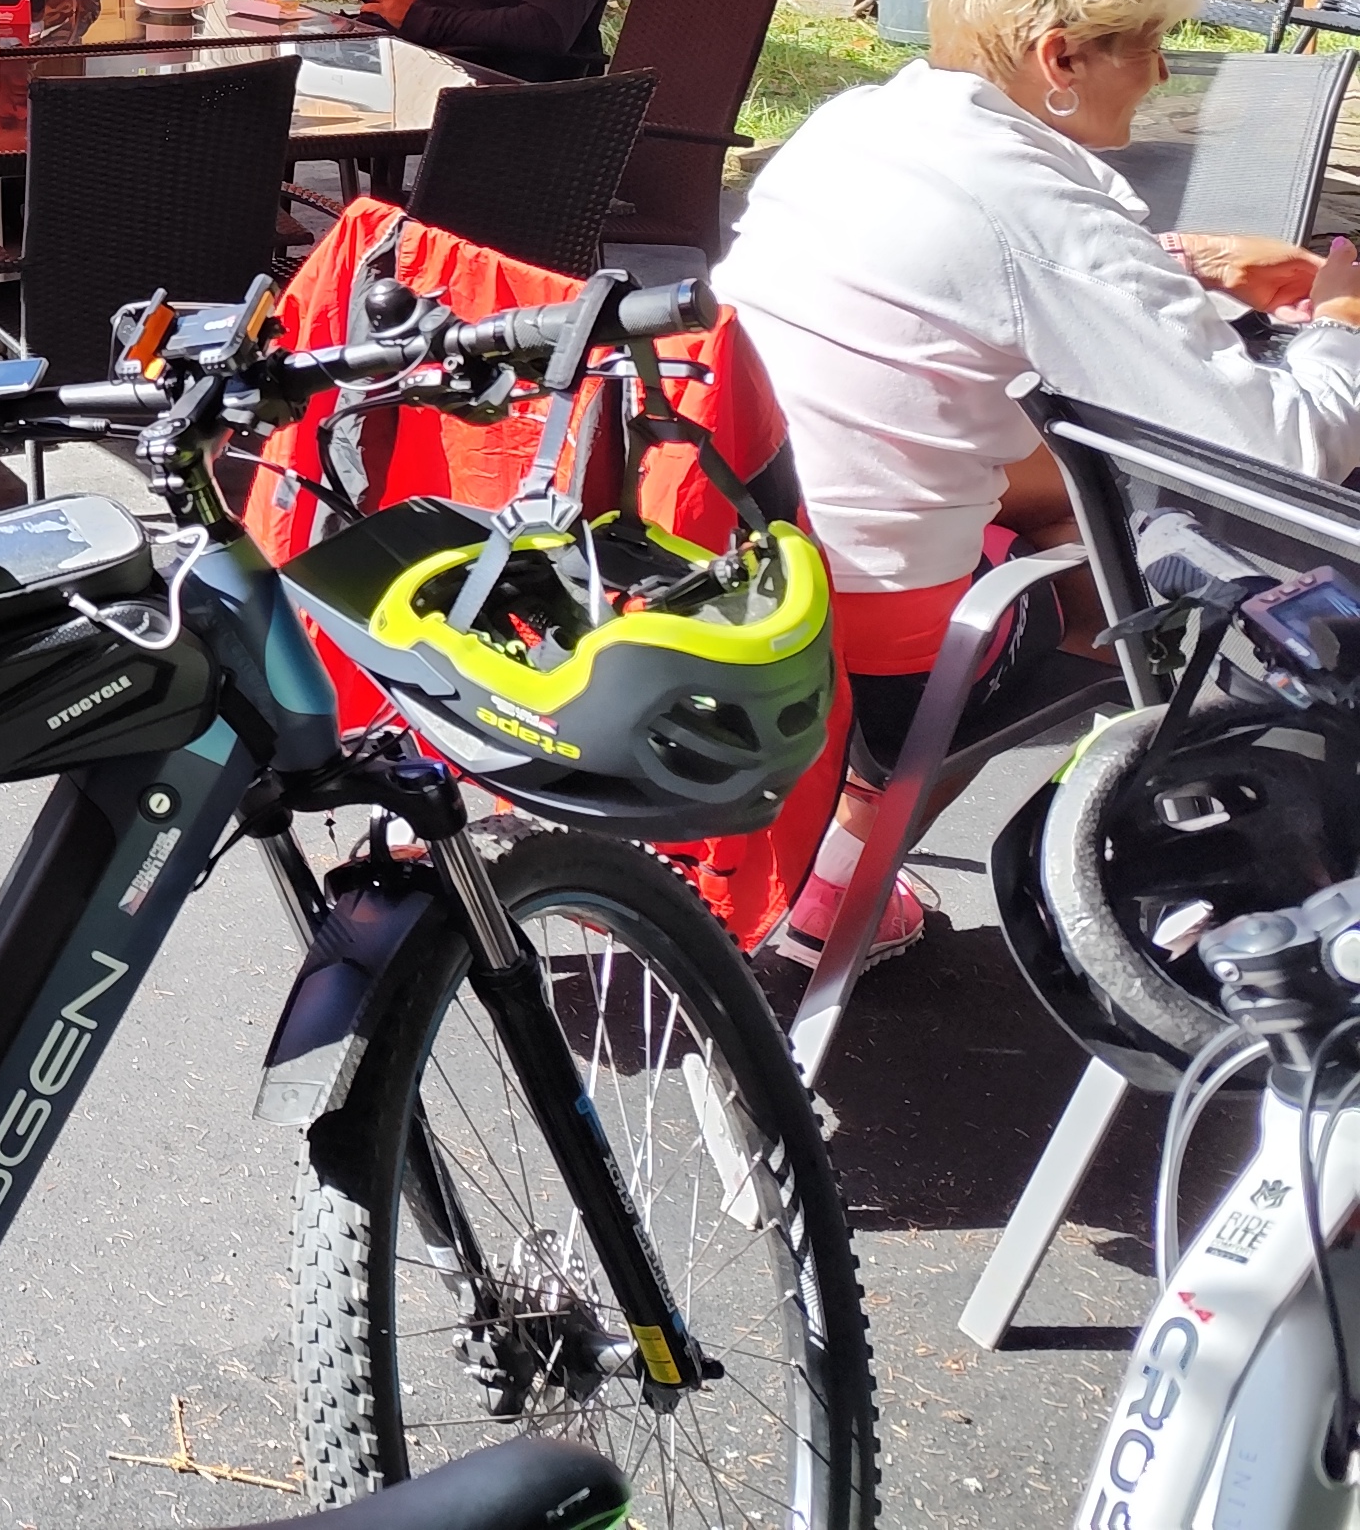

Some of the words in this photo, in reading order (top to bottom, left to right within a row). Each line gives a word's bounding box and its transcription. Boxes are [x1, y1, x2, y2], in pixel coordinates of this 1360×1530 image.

[476, 706, 582, 760] etape
[602, 1153, 635, 1215] XCM30
[1215, 1223, 1267, 1251] LITE
[1230, 1210, 1276, 1238] RIDE
